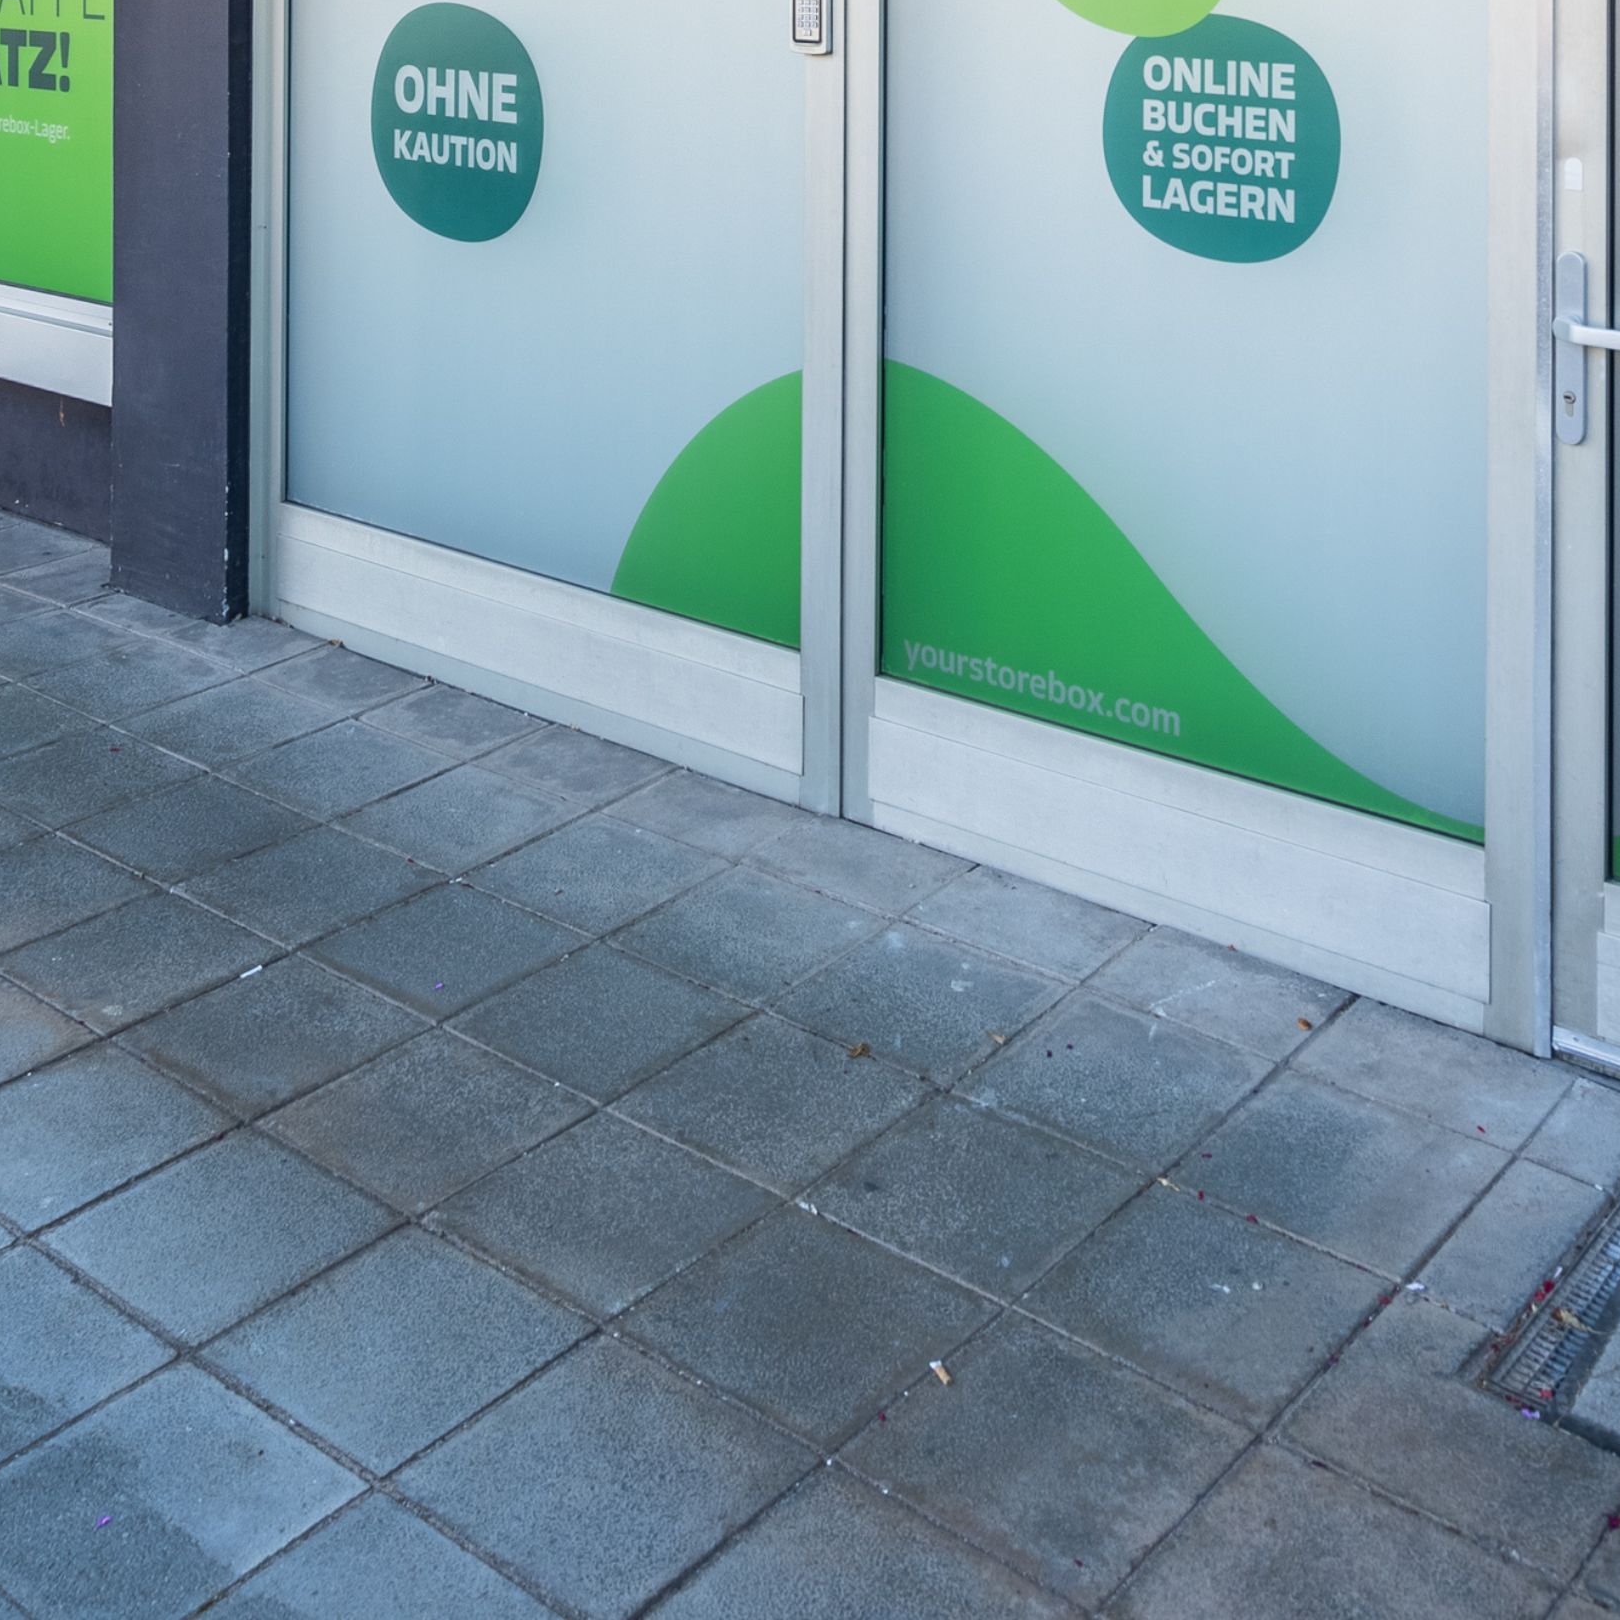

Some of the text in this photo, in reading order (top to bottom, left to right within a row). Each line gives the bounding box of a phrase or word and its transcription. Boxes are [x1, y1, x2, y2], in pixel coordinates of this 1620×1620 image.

[394, 63, 519, 125] OHNE
[1142, 54, 1297, 101] ONLINE
[1142, 98, 1297, 144] BUCHEN
[393, 129, 518, 174] KAUTION
[1142, 140, 1296, 180] & SOFORT
[1141, 175, 1297, 225] LAGERN
[904, 638, 1181, 737] yourstorebox.com
